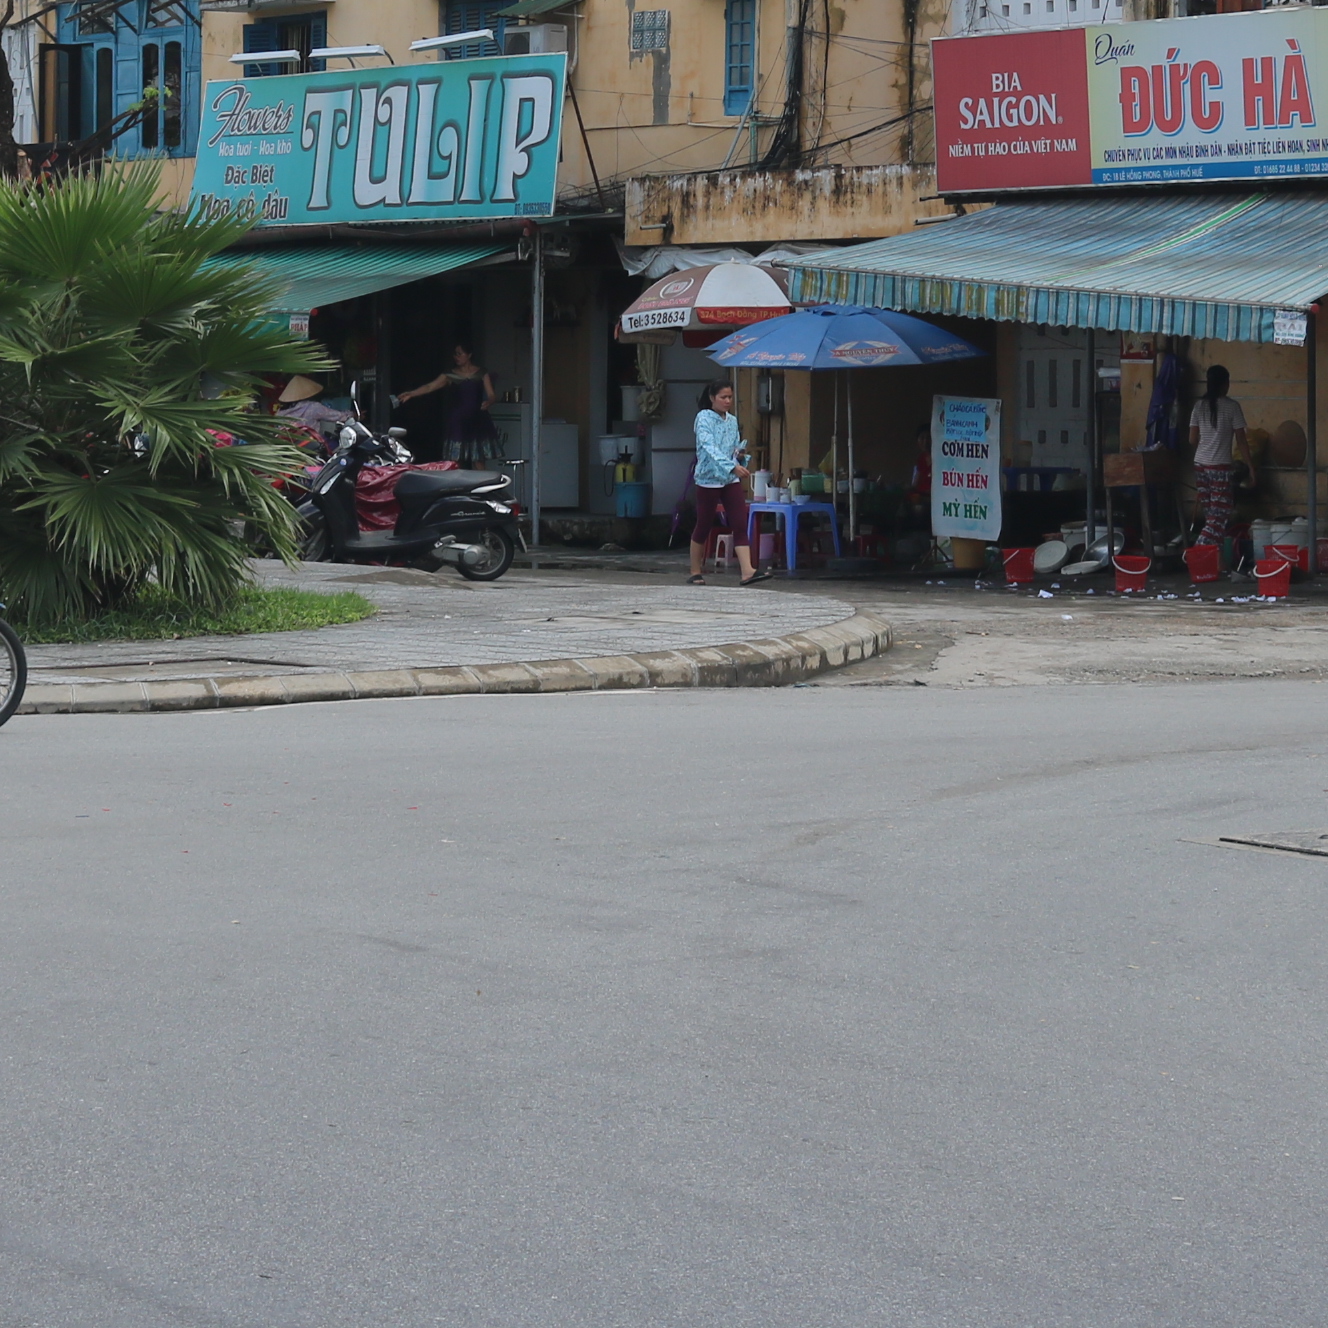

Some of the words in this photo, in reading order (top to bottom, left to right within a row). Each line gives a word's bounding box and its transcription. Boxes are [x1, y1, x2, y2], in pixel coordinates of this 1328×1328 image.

[1094, 33, 1135, 65] Quán
[991, 72, 1022, 93] BIA
[1118, 47, 1224, 137] ĐỨC
[1242, 38, 1316, 130] HÀ
[208, 84, 294, 147] Flowers
[959, 93, 1057, 130] SAIGON
[218, 142, 234, 157] Hoa
[259, 140, 275, 156] Hoa
[277, 139, 292, 155] khô
[301, 72, 554, 211] TULIP
[949, 139, 971, 158] NIỀM
[973, 142, 987, 158] TỰ
[988, 138, 1008, 156] HÀO
[1011, 137, 1030, 154] CỦA
[1030, 137, 1051, 155] VIỆT
[1054, 138, 1077, 152] NAM
[1104, 146, 1126, 162] CHUYÊN
[1127, 148, 1142, 163] PHỤC
[1152, 144, 1164, 160] CÁC
[1178, 142, 1193, 161] NHẬU
[1195, 142, 1209, 158] BÌNH
[1211, 140, 1223, 157] DÂN
[1227, 139, 1243, 159] NHẬN
[1257, 138, 1272, 158] TIỆC
[1272, 137, 1286, 154] LIÊN
[1306, 138, 1321, 152] SINH
[224, 164, 247, 190] Đặc
[250, 163, 275, 190] Biệt
[262, 187, 289, 221] dâu
[942, 439, 964, 457] CƠM
[942, 468, 964, 487] BÚN
[966, 467, 988, 490] HẾN
[942, 498, 960, 518] MỲ
[964, 497, 988, 520] HẾN
